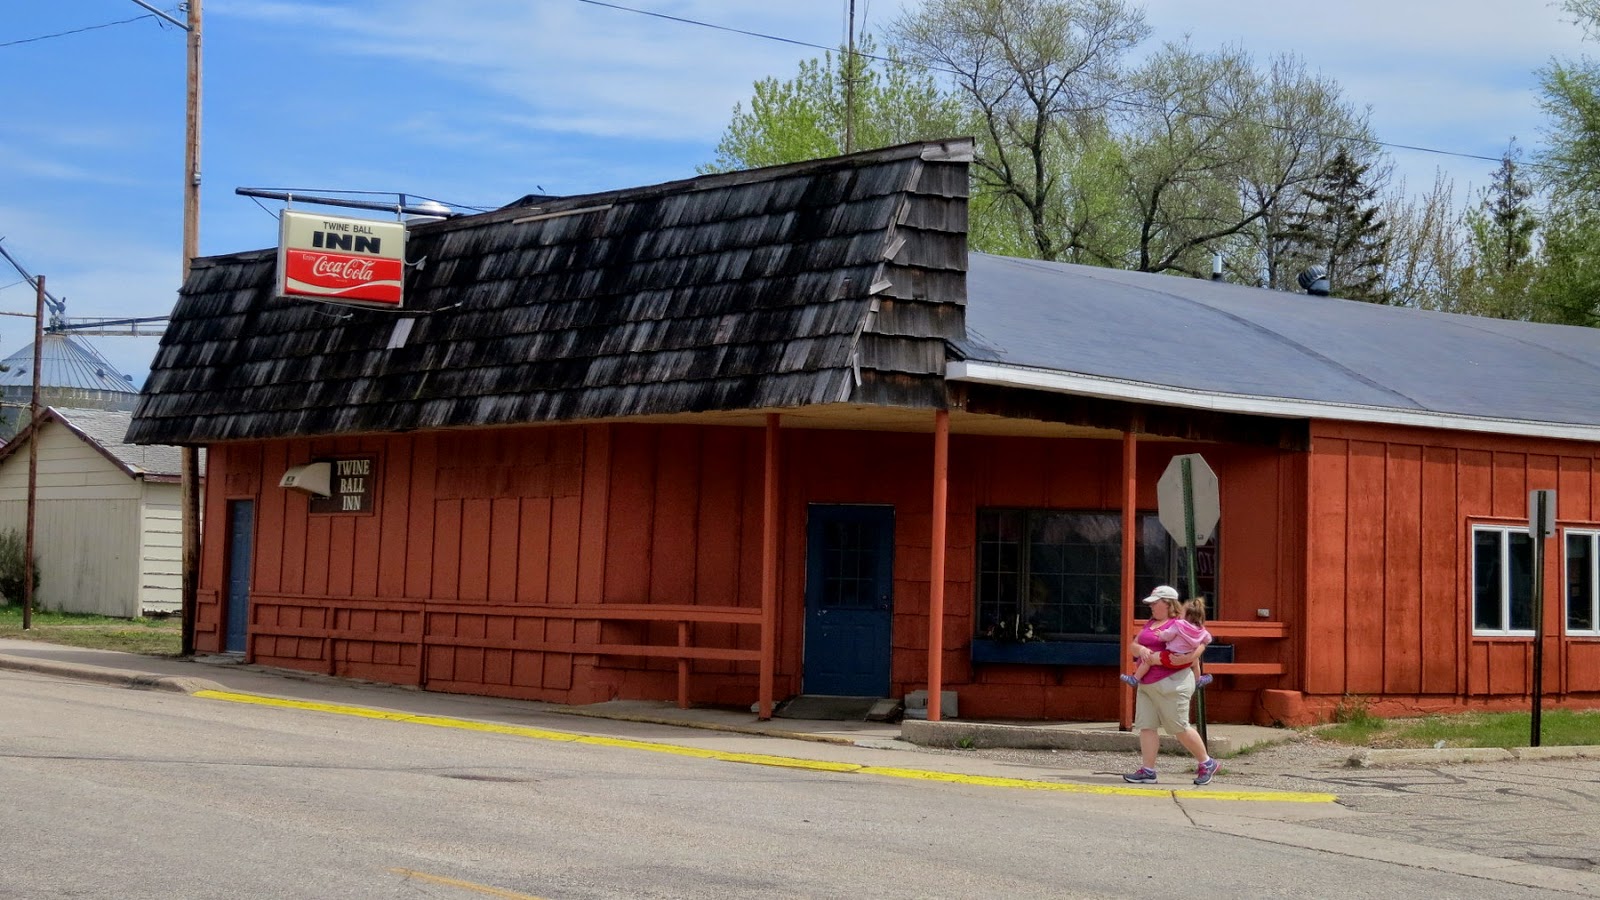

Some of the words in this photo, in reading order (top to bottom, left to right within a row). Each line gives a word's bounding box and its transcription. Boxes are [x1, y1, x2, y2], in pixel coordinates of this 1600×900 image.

[323, 221, 349, 232] TWINE
[353, 225, 373, 234] BALL
[312, 231, 381, 254] INN
[336, 460, 370, 475] TWINE
[340, 478, 365, 493] BALL
[342, 495, 361, 510] INN
